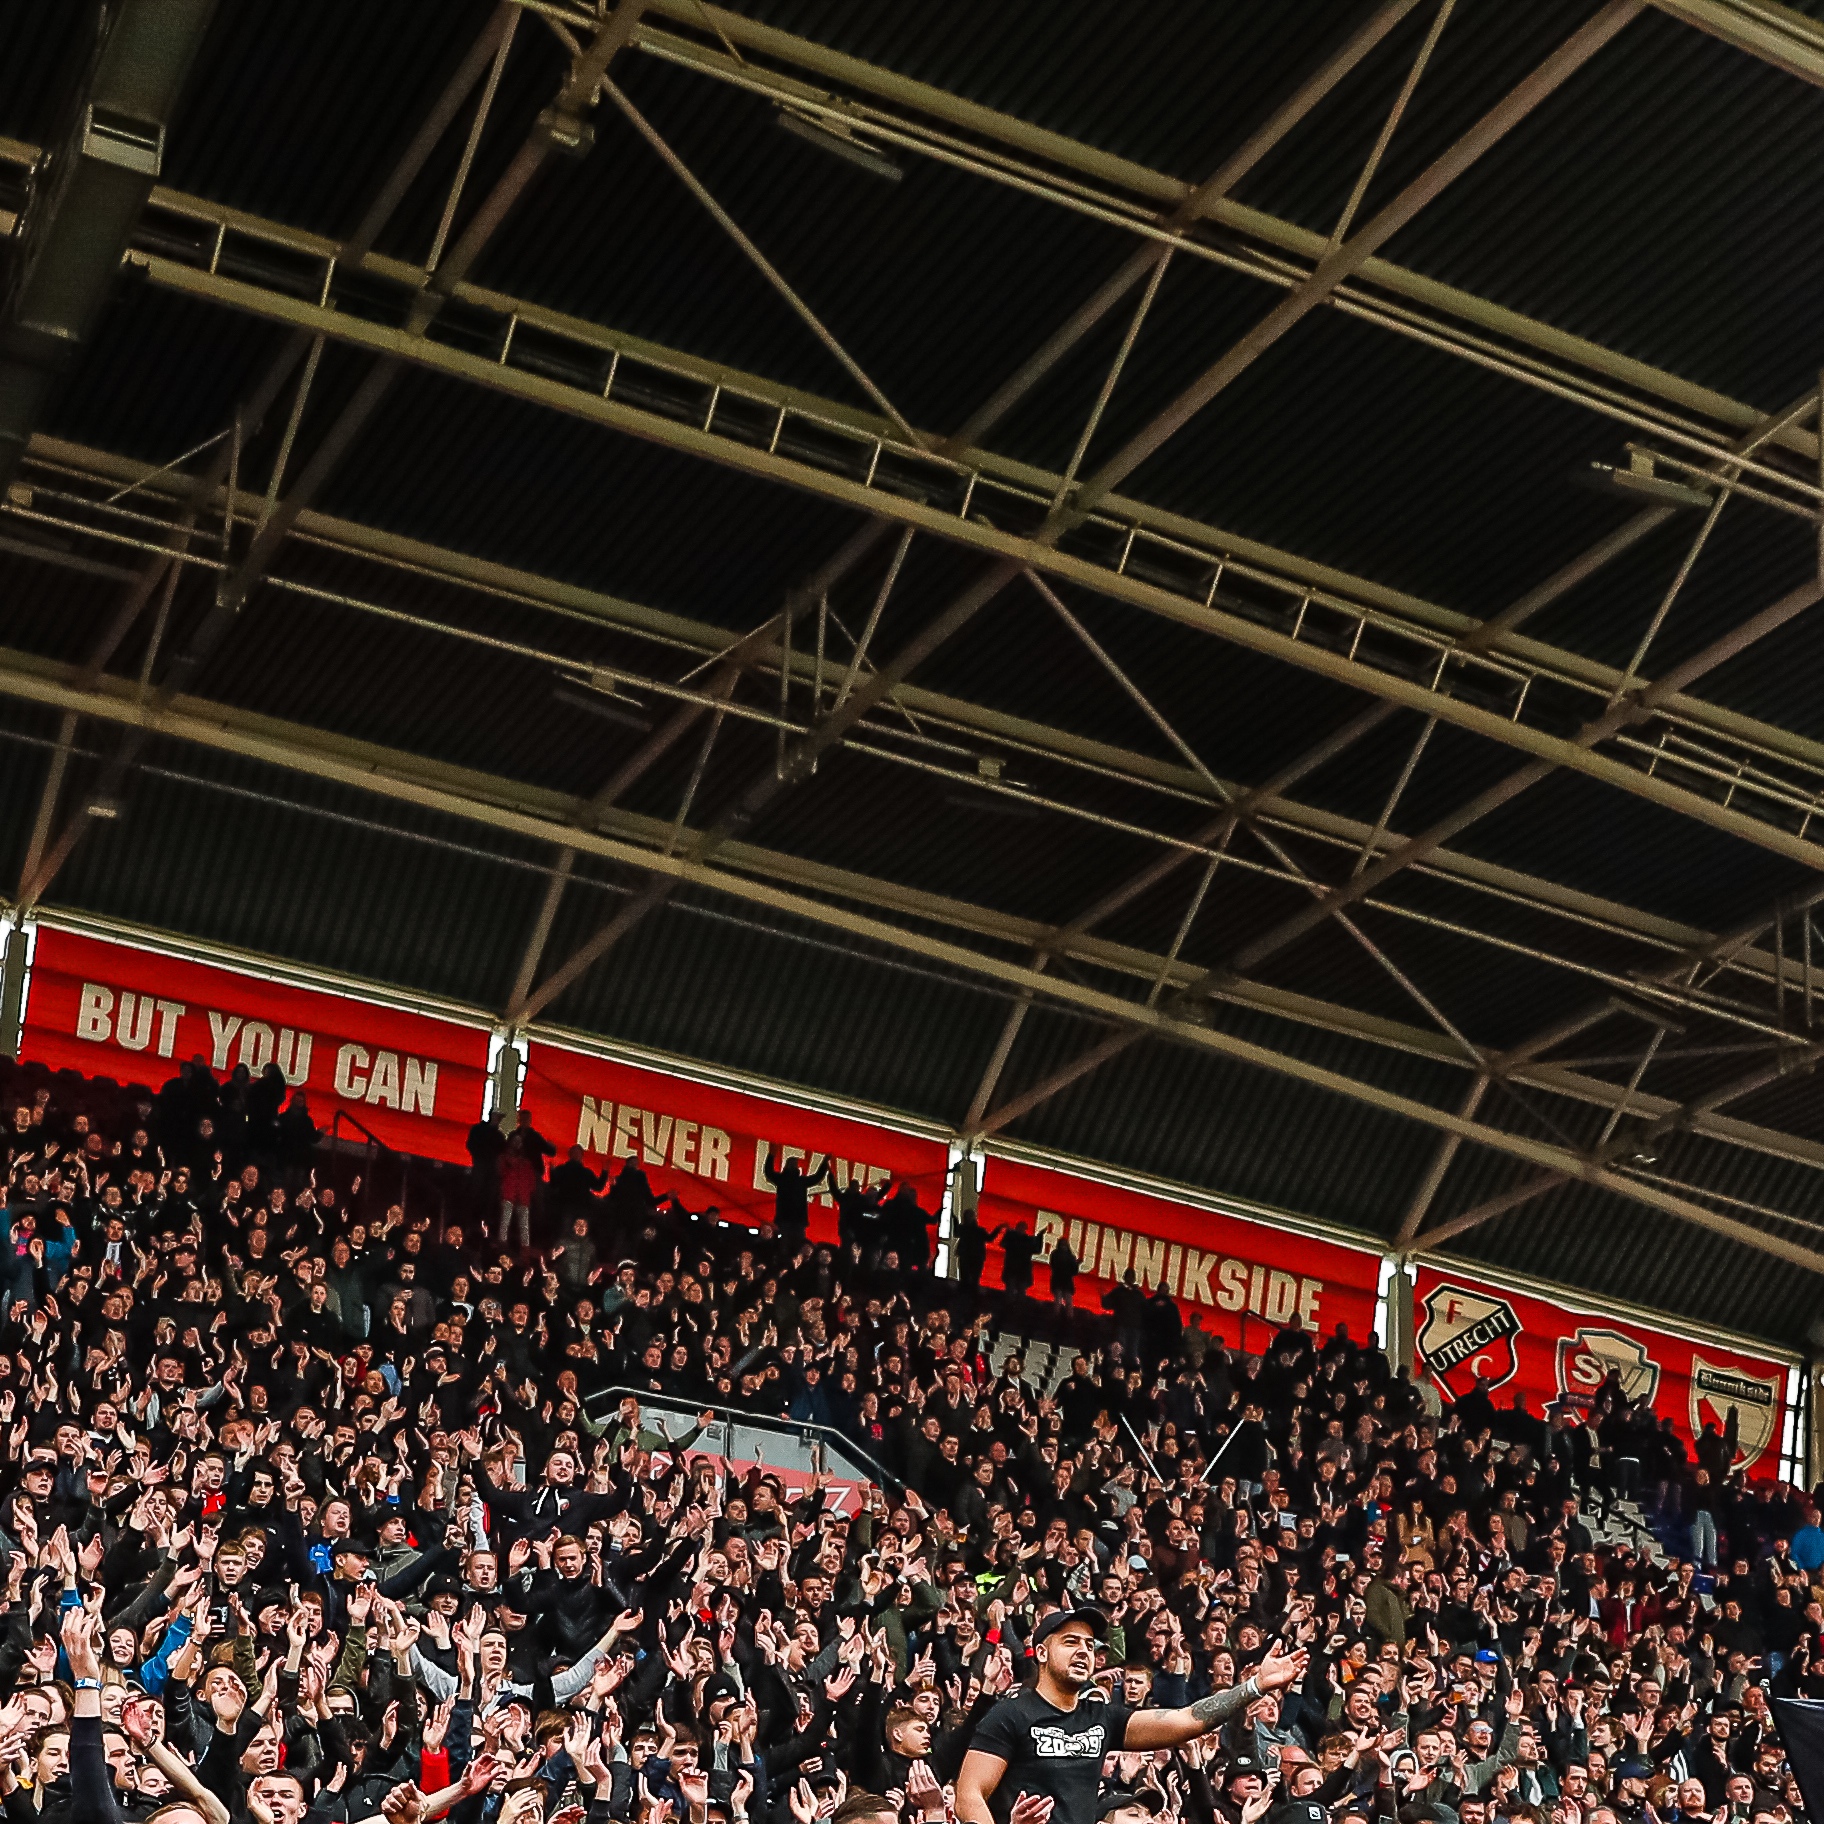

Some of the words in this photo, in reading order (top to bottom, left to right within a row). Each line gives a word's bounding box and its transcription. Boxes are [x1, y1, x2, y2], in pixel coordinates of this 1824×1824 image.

[76, 982, 186, 1058] BUT
[208, 1011, 313, 1087] YOU
[333, 1043, 438, 1116] CAN
[578, 1095, 731, 1181] NEVER
[1032, 1210, 1324, 1332] BUNNIKSIDE
[1429, 1310, 1510, 1371] UTRECHT
[1445, 1299, 1463, 1324] F
[1471, 1355, 1493, 1379] C
